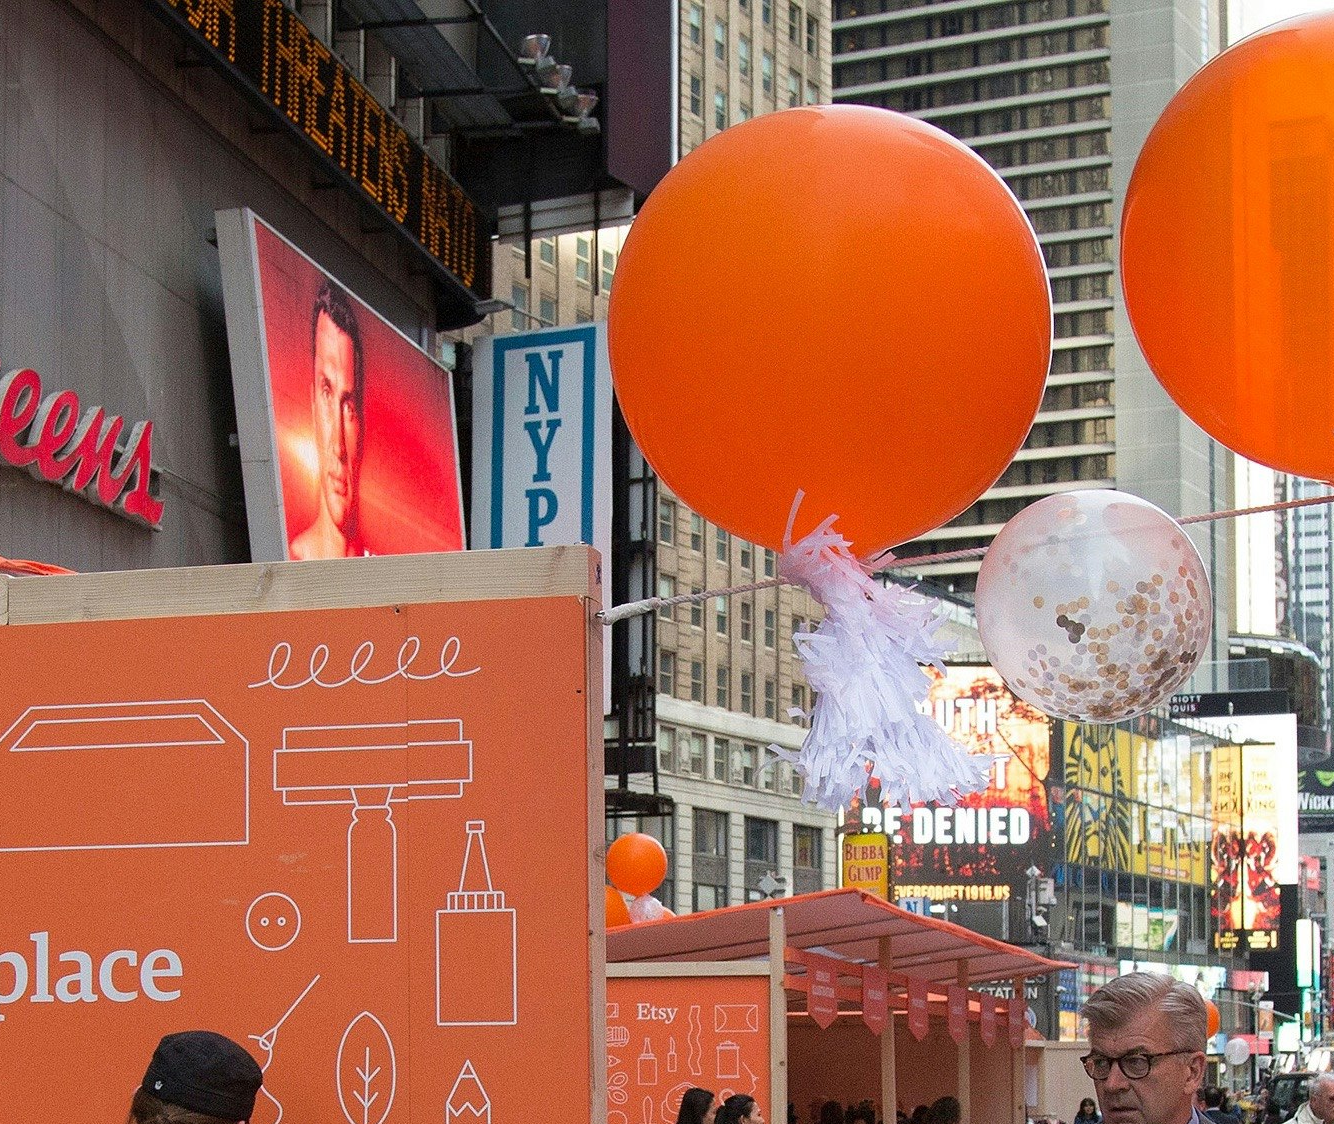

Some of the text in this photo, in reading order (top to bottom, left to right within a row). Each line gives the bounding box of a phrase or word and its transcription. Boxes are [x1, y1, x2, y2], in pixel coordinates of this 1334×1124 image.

[913, 807, 1030, 845] DENIED
[845, 844, 885, 861] BUBBA
[848, 864, 883, 883] GUMP
[978, 985, 1038, 1000] TATIN
[636, 1003, 679, 1024] Etsy
